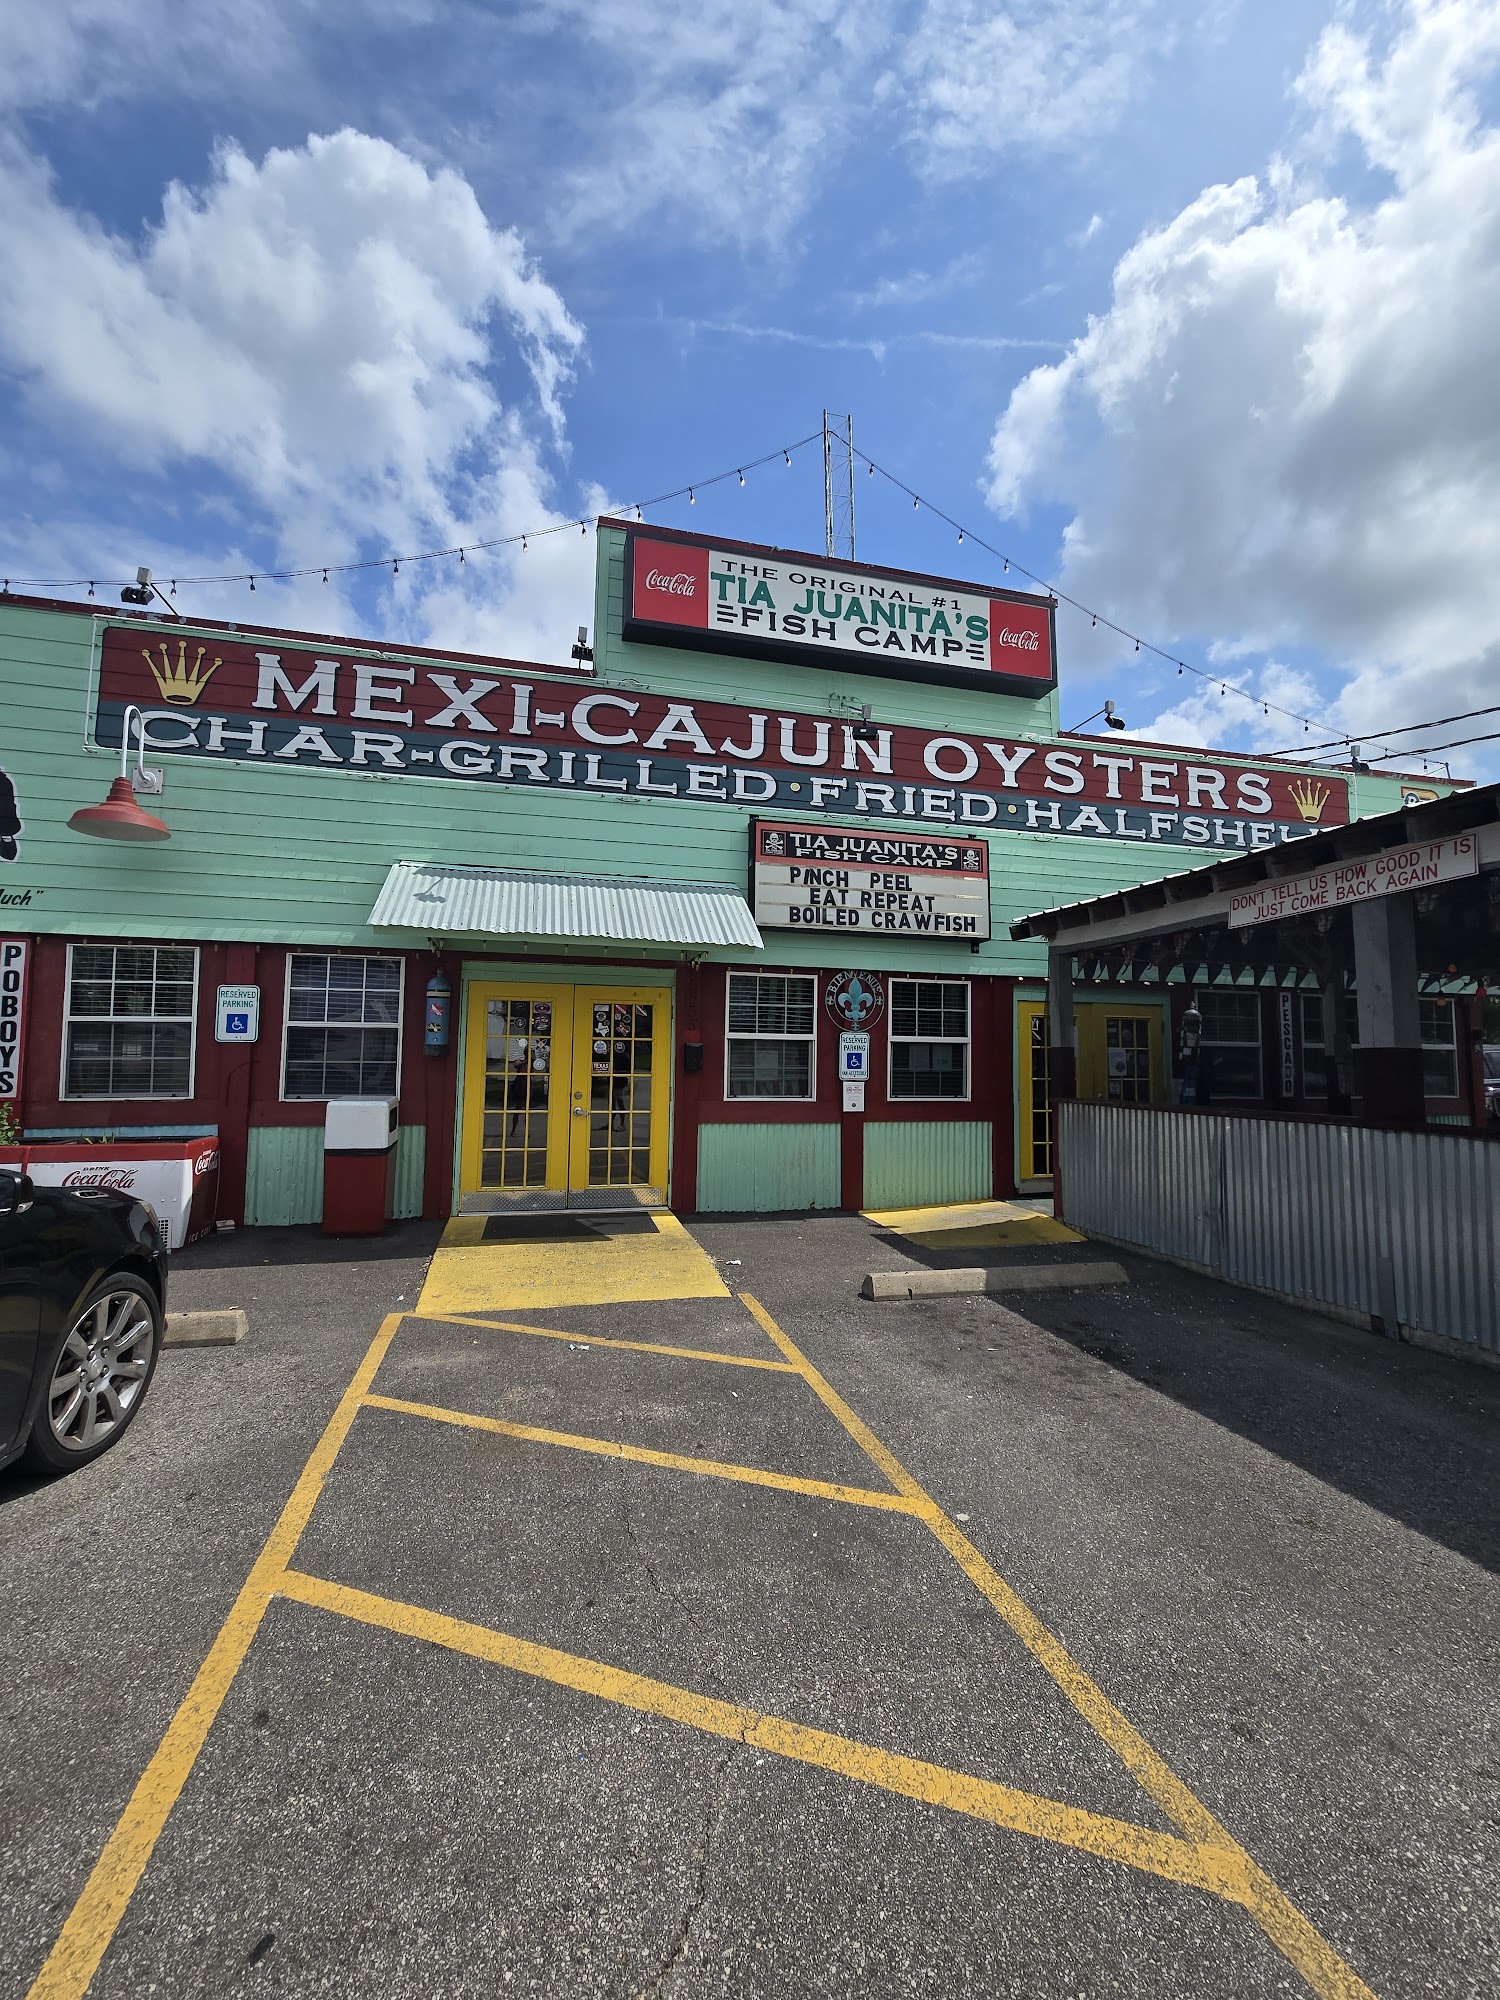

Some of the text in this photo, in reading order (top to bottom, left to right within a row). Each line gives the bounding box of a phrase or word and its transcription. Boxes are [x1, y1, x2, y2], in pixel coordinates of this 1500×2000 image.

[645, 568, 697, 598] Coca-Cola
[722, 560, 962, 610] THE ORIGINAL #1
[711, 571, 989, 642] TIA JUANITA'S
[741, 607, 964, 659] FISH CAMP
[999, 626, 1040, 652] Coca-Cola
[252, 652, 1274, 815] MEXI-CAJUN OYSTERS
[132, 710, 1319, 848] CHAR-GRILLED FRIED HALFSHEL
[789, 833, 958, 860] TIA JUANITA'S
[795, 848, 863, 862] FISH
[871, 854, 953, 868] CAMP
[789, 867, 913, 892] PINCH PEEL
[1232, 837, 1472, 912] DON'T TELL US HOW GOOD IT IS
[0, 888, 44, 906] uch"
[809, 888, 936, 912] EAT REPEAT
[1253, 863, 1439, 920] JUST COME BACK AGAIN
[789, 906, 976, 932] BOILED CRAWFISH
[221, 990, 257, 999] RESERVED
[222, 1000, 254, 1008] PARKING
[0, 945, 22, 1094] POBOYS
[1281, 994, 1292, 1093] PESCADO
[62, 1169, 139, 1189] Coca-Cola
